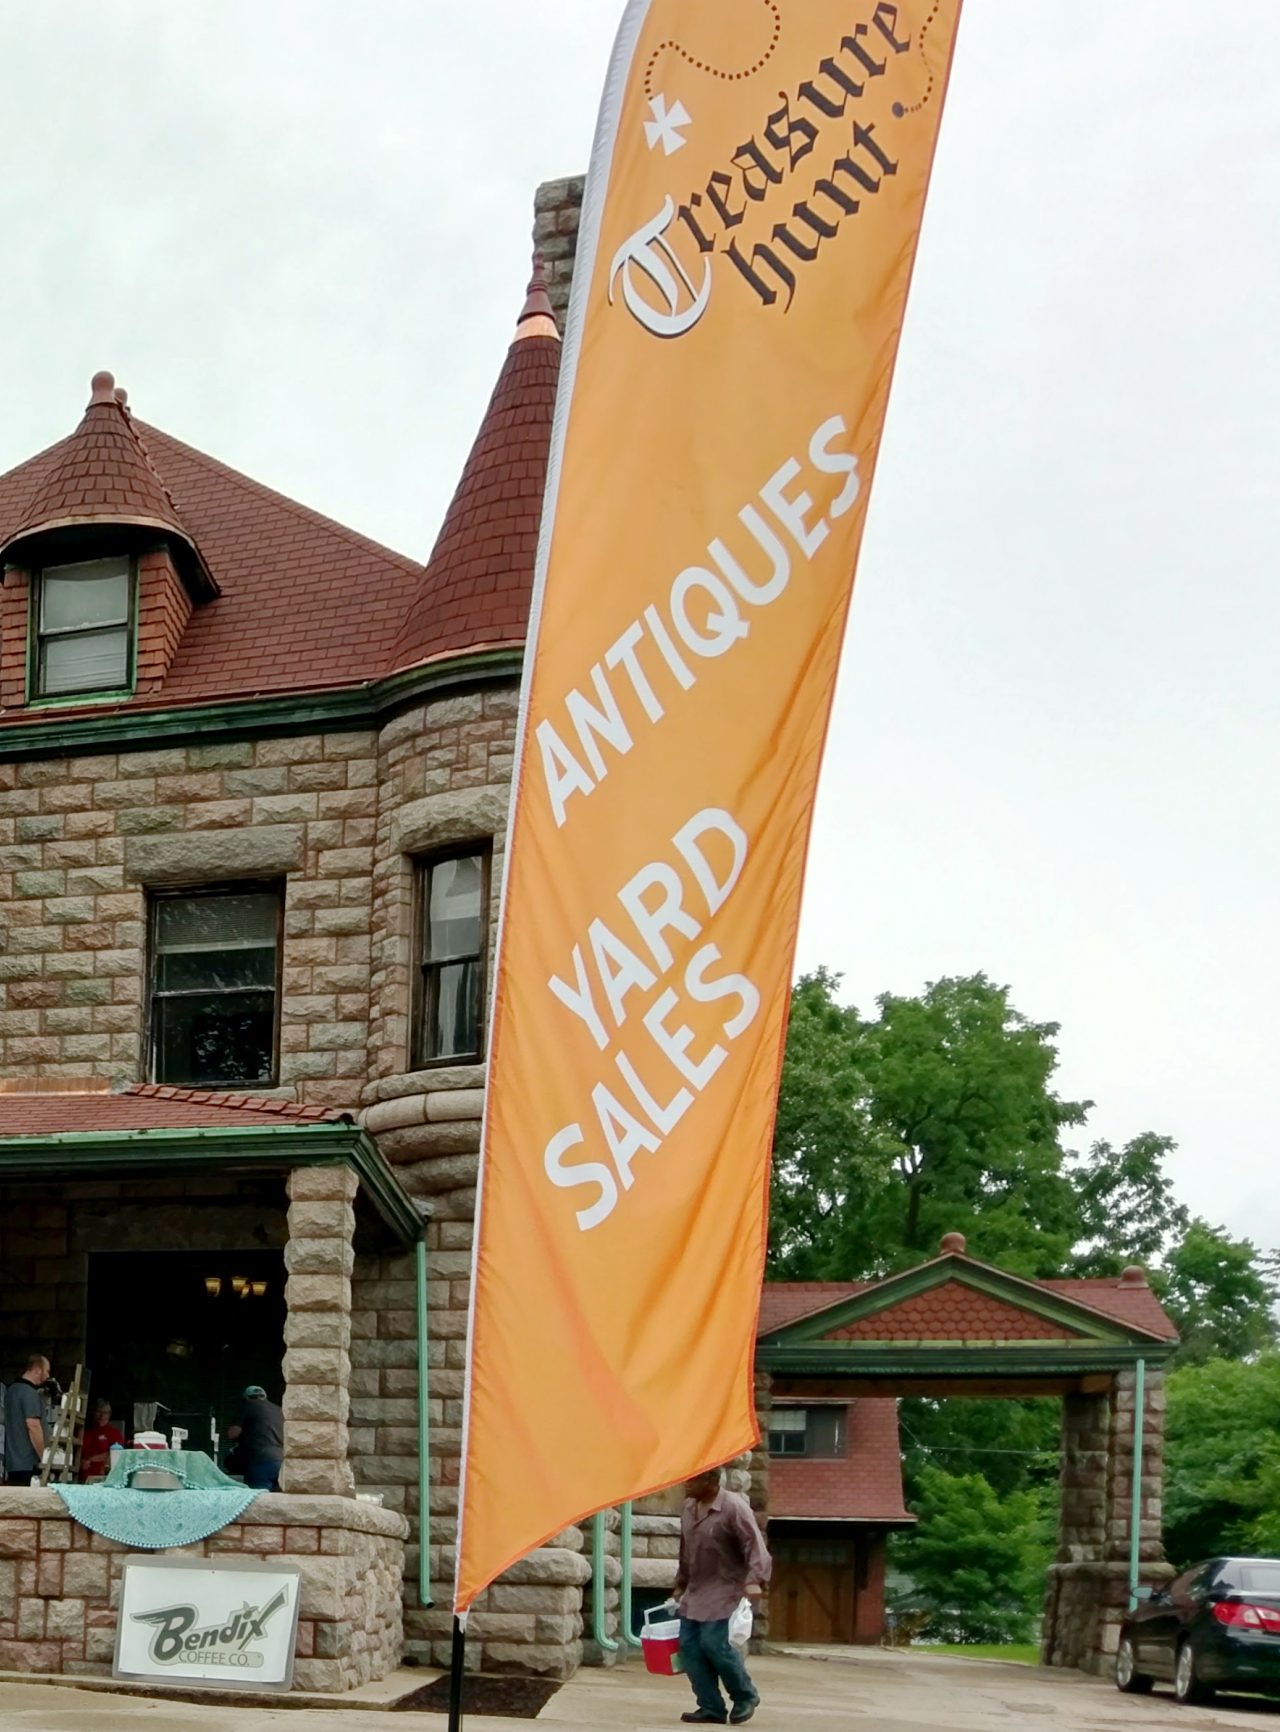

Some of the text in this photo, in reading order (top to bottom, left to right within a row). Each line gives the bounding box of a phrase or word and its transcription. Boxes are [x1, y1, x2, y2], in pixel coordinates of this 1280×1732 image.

[608, 1, 912, 339] Treasure
[721, 120, 899, 314] hunt
[534, 414, 860, 828] ANTIQUES
[547, 807, 748, 1051] YARD
[543, 942, 761, 1232] SALES
[132, 1591, 285, 1661] Bendix
[178, 1650, 226, 1664] COFFEE
